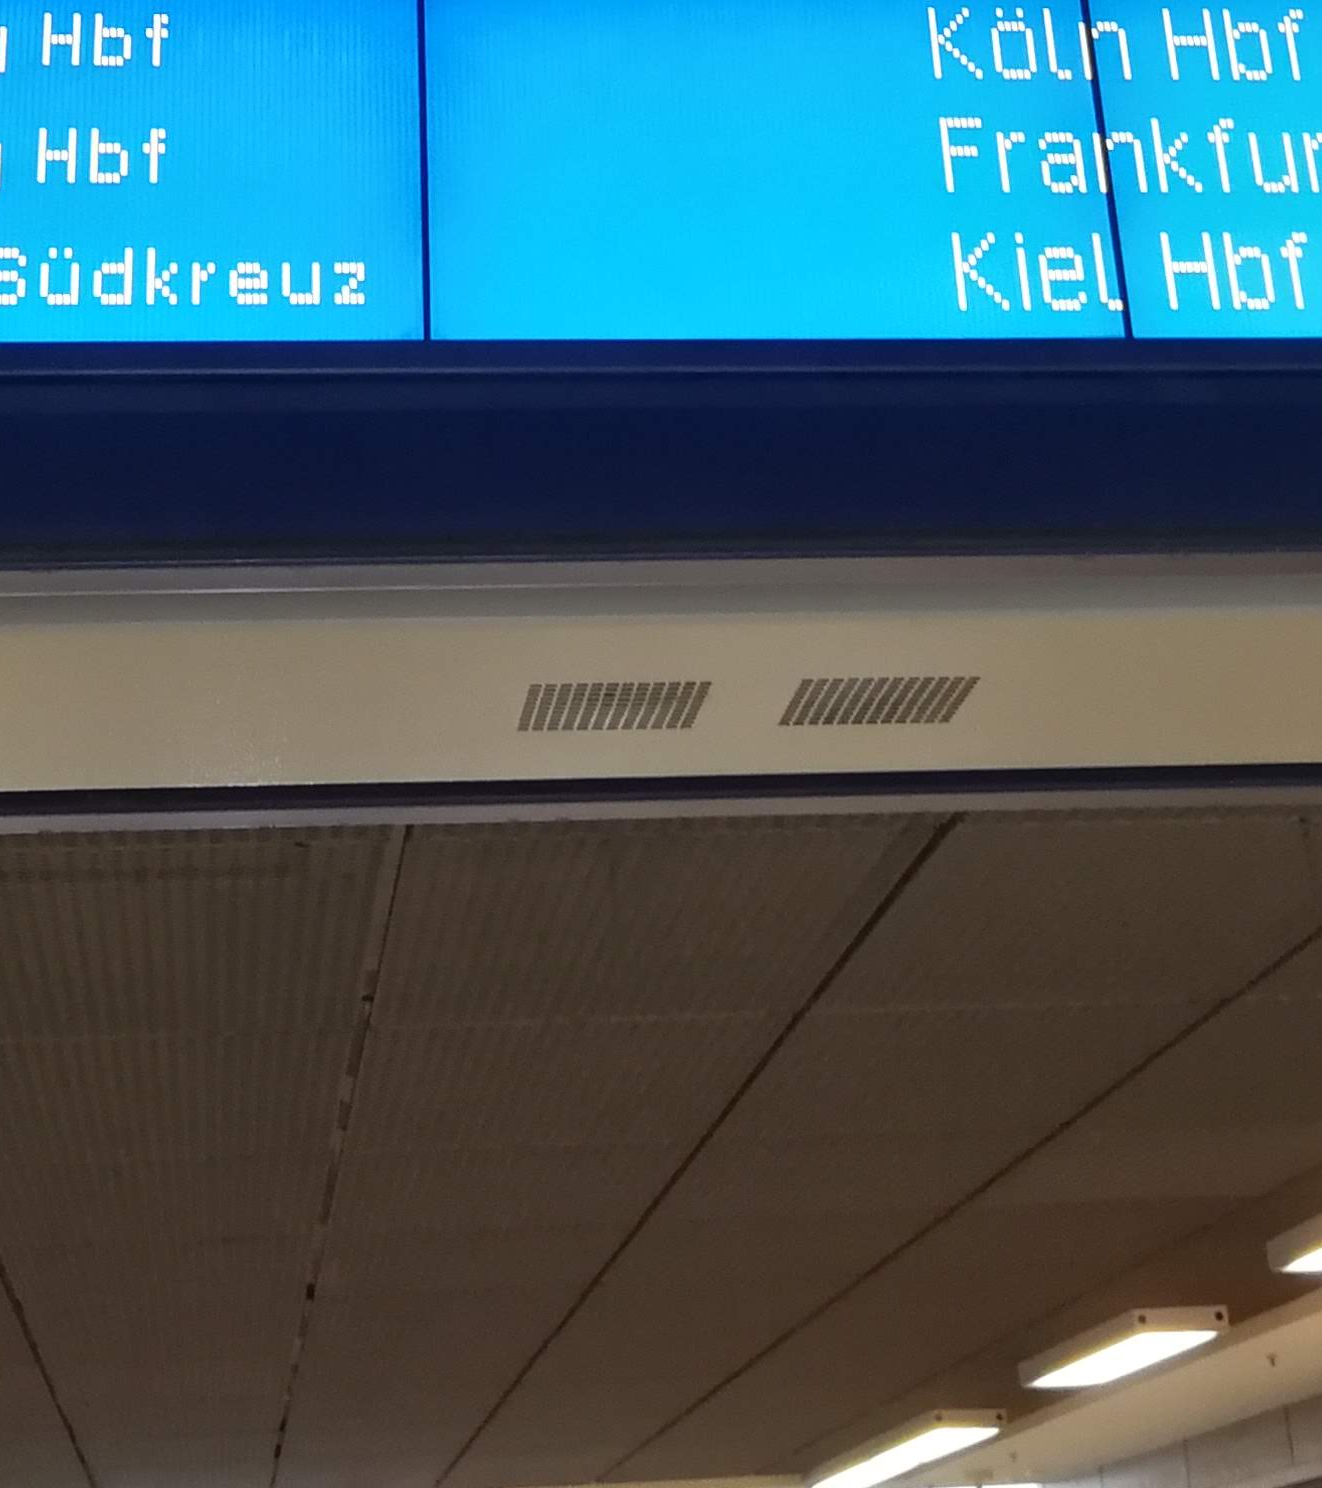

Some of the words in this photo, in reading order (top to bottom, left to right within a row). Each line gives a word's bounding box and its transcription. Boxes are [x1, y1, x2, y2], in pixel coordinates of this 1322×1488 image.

[42, 13, 168, 66] Hbf
[928, 8, 1131, 80] Köln
[1163, 9, 1303, 80] Hbf
[37, 128, 166, 183] Hbf
[952, 233, 1123, 311] Kiel
[1160, 232, 1307, 309] Hbf
